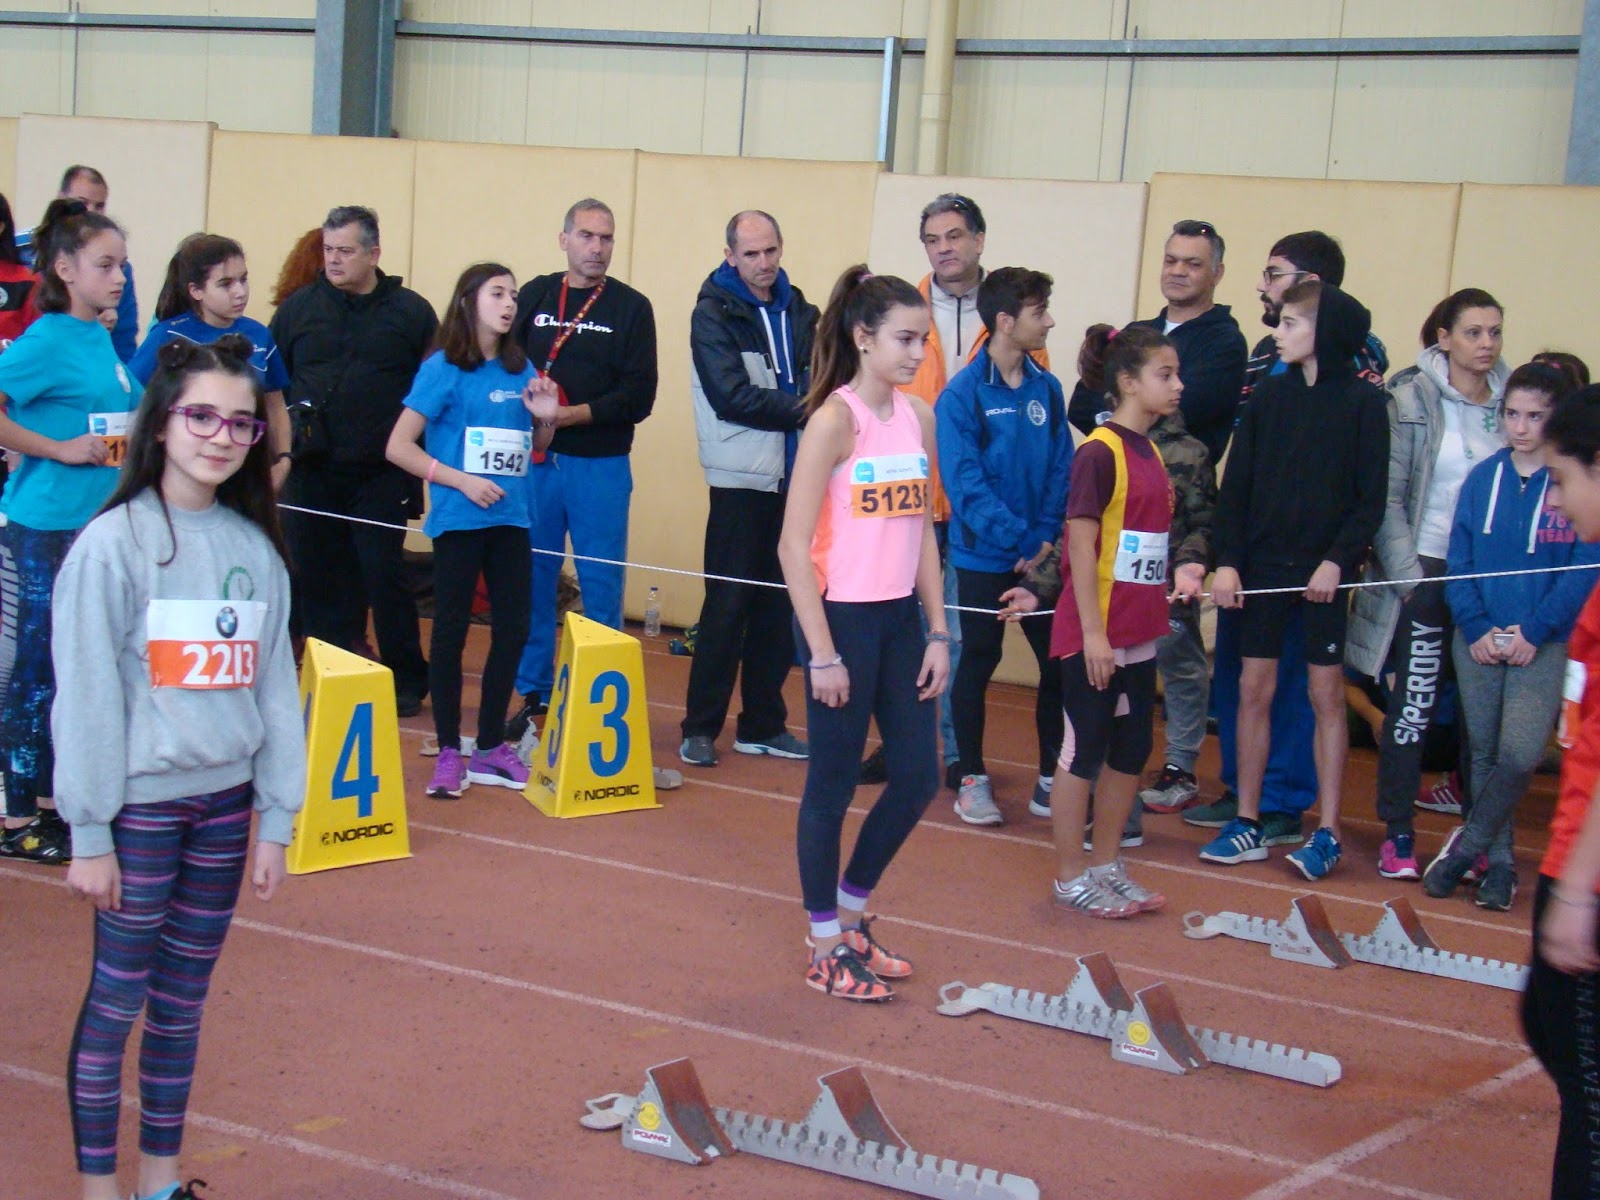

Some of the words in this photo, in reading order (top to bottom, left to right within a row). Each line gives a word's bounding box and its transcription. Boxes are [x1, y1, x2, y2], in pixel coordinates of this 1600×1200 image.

[480, 450, 524, 473] 1542
[181, 643, 254, 685] 2213
[547, 663, 569, 769] 3
[588, 670, 631, 778] 3
[331, 702, 380, 819] 4
[584, 784, 640, 801] NORDIC
[333, 822, 395, 844] NORDIC
